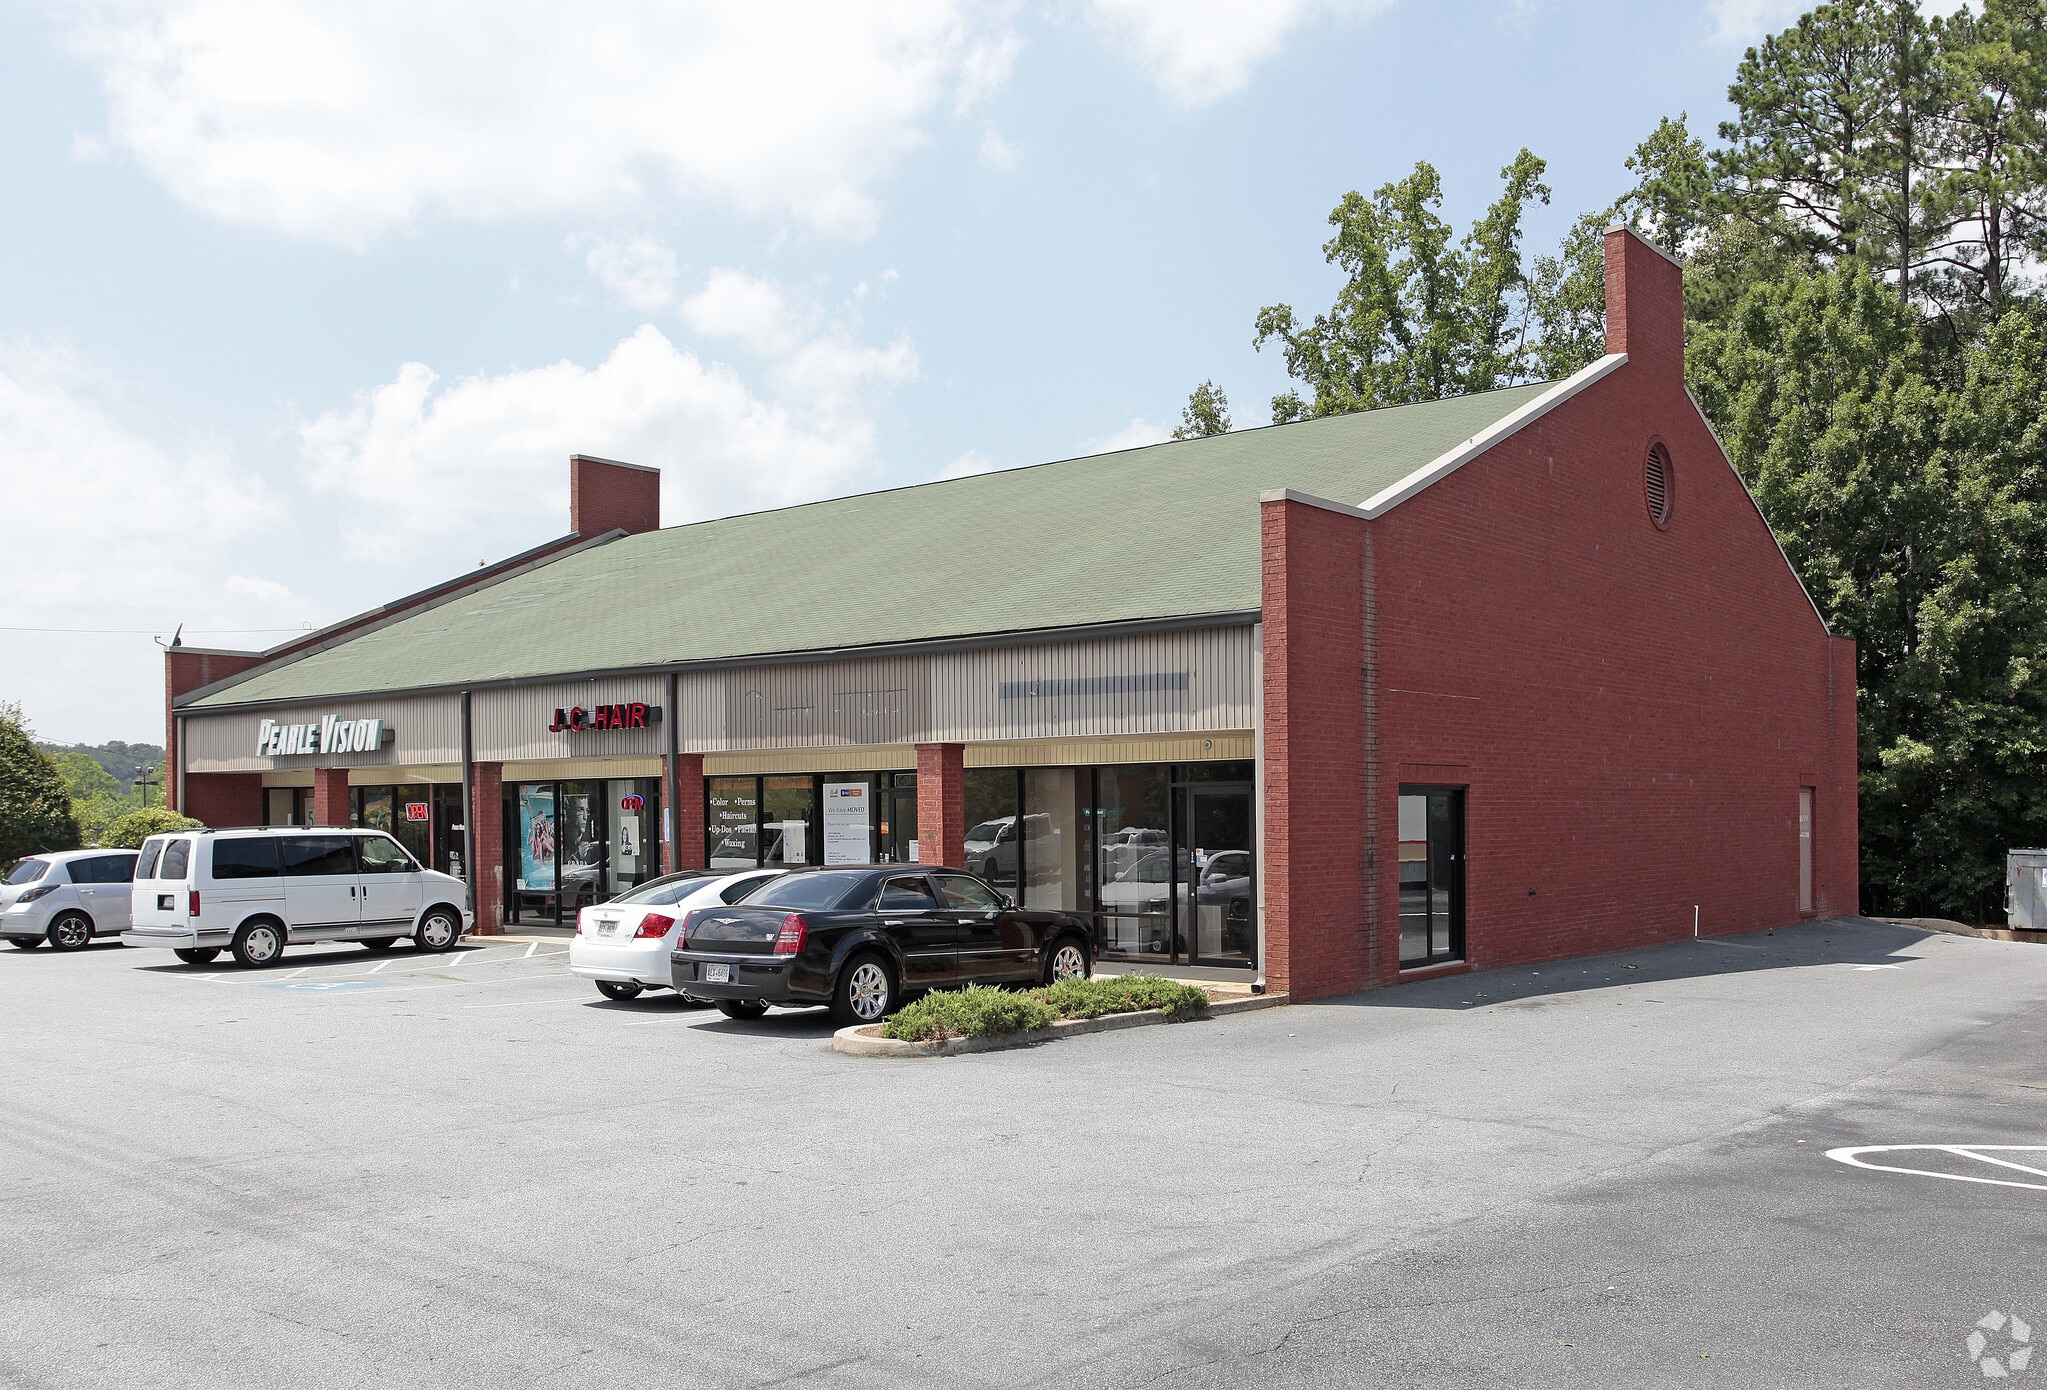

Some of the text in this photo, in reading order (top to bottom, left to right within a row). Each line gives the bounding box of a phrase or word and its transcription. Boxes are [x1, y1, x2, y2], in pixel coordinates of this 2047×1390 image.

[595, 702, 646, 731] HAIR
[256, 714, 382, 756] PEARLE VISION
[407, 805, 427, 819] OPEN
[620, 797, 643, 811] OPEN
